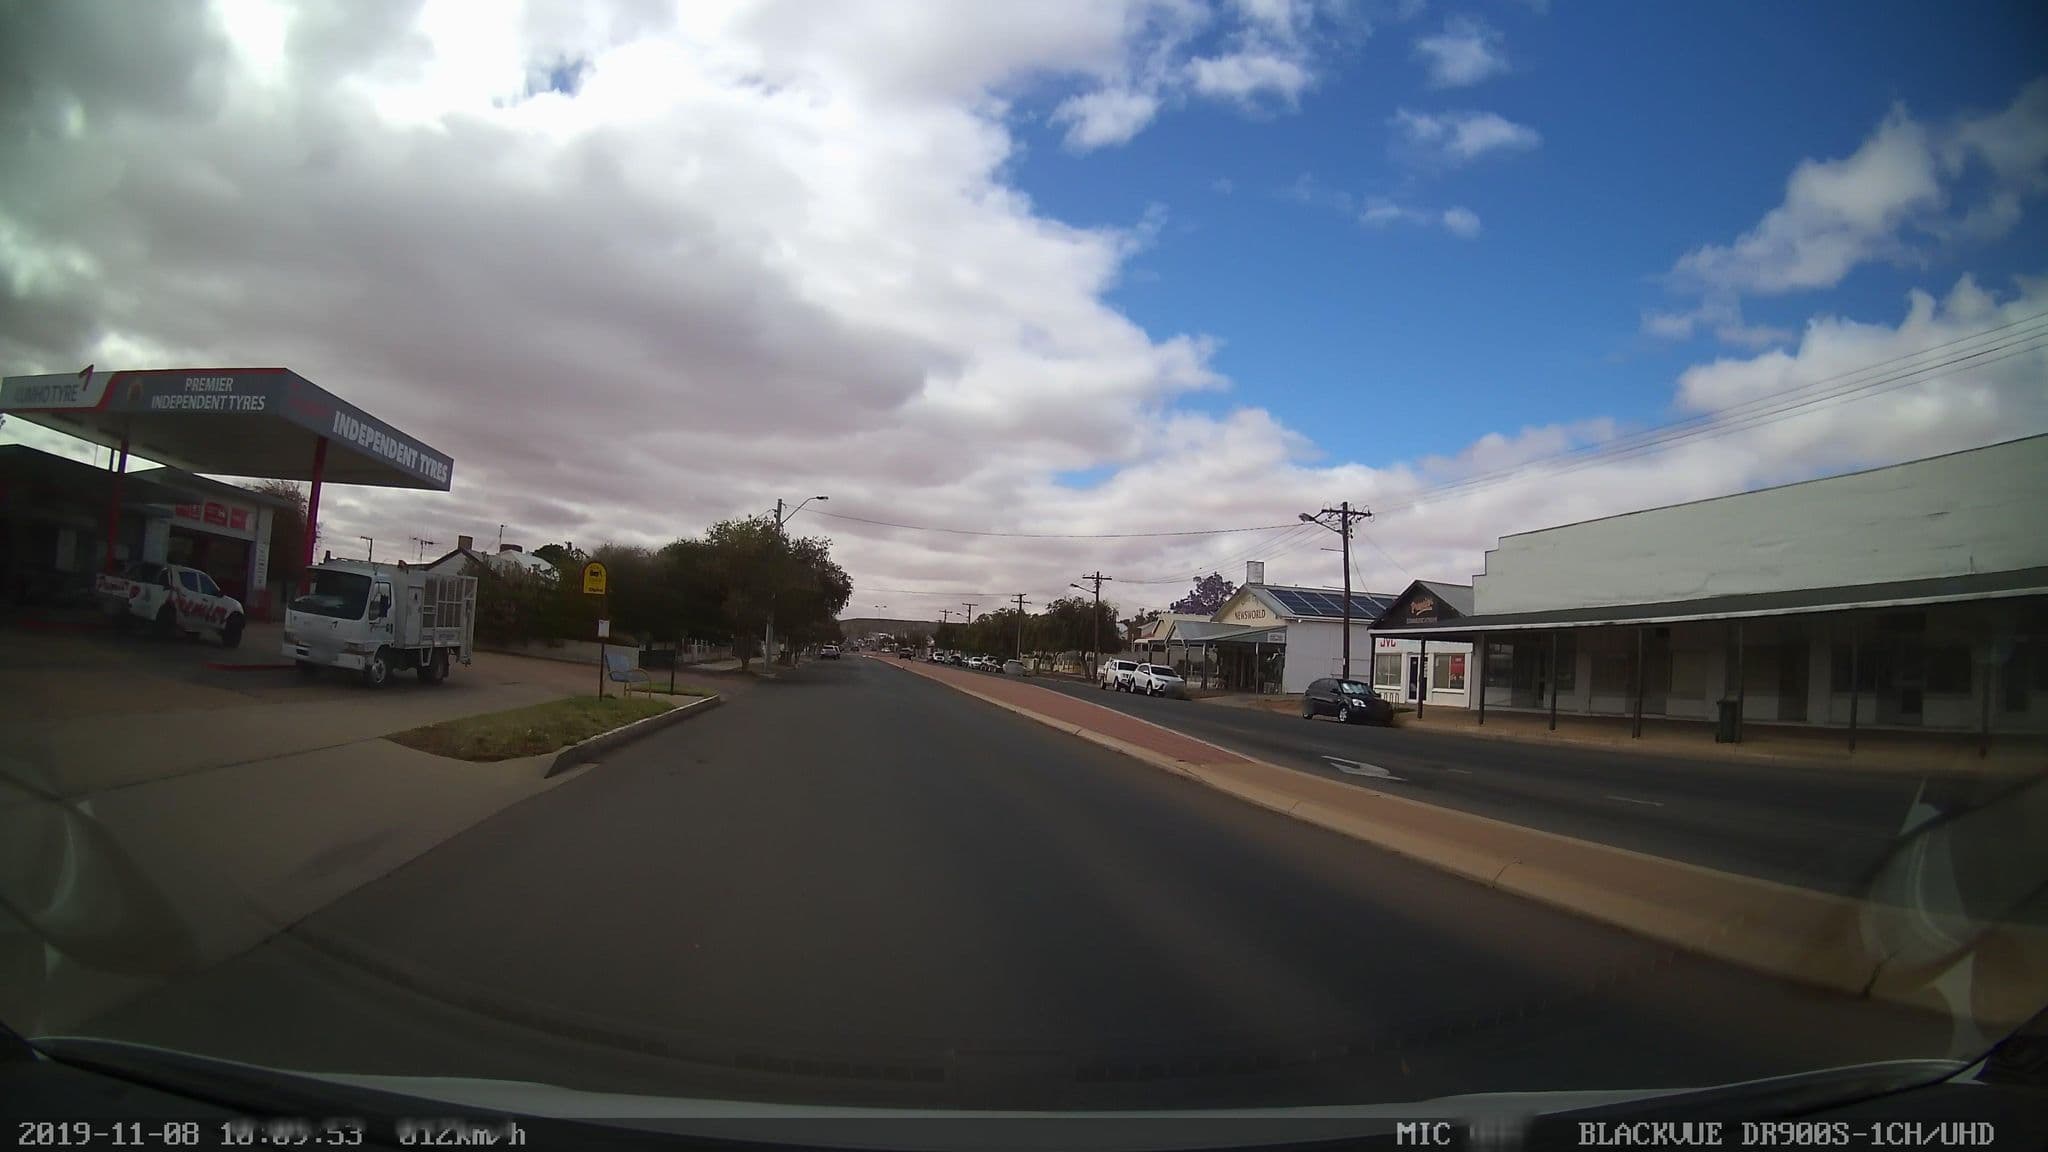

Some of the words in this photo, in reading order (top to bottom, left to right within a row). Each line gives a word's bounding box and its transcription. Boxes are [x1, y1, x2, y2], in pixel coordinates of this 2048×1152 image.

[185, 377, 233, 392] PREMIER
[51, 384, 79, 402] TYRE
[151, 395, 227, 410] INDEPENDENT
[228, 395, 265, 411] TYRES
[333, 411, 417, 468] INDEPENDENT
[419, 454, 448, 482] TYRES
[1234, 609, 1266, 620] NEWSWORLD
